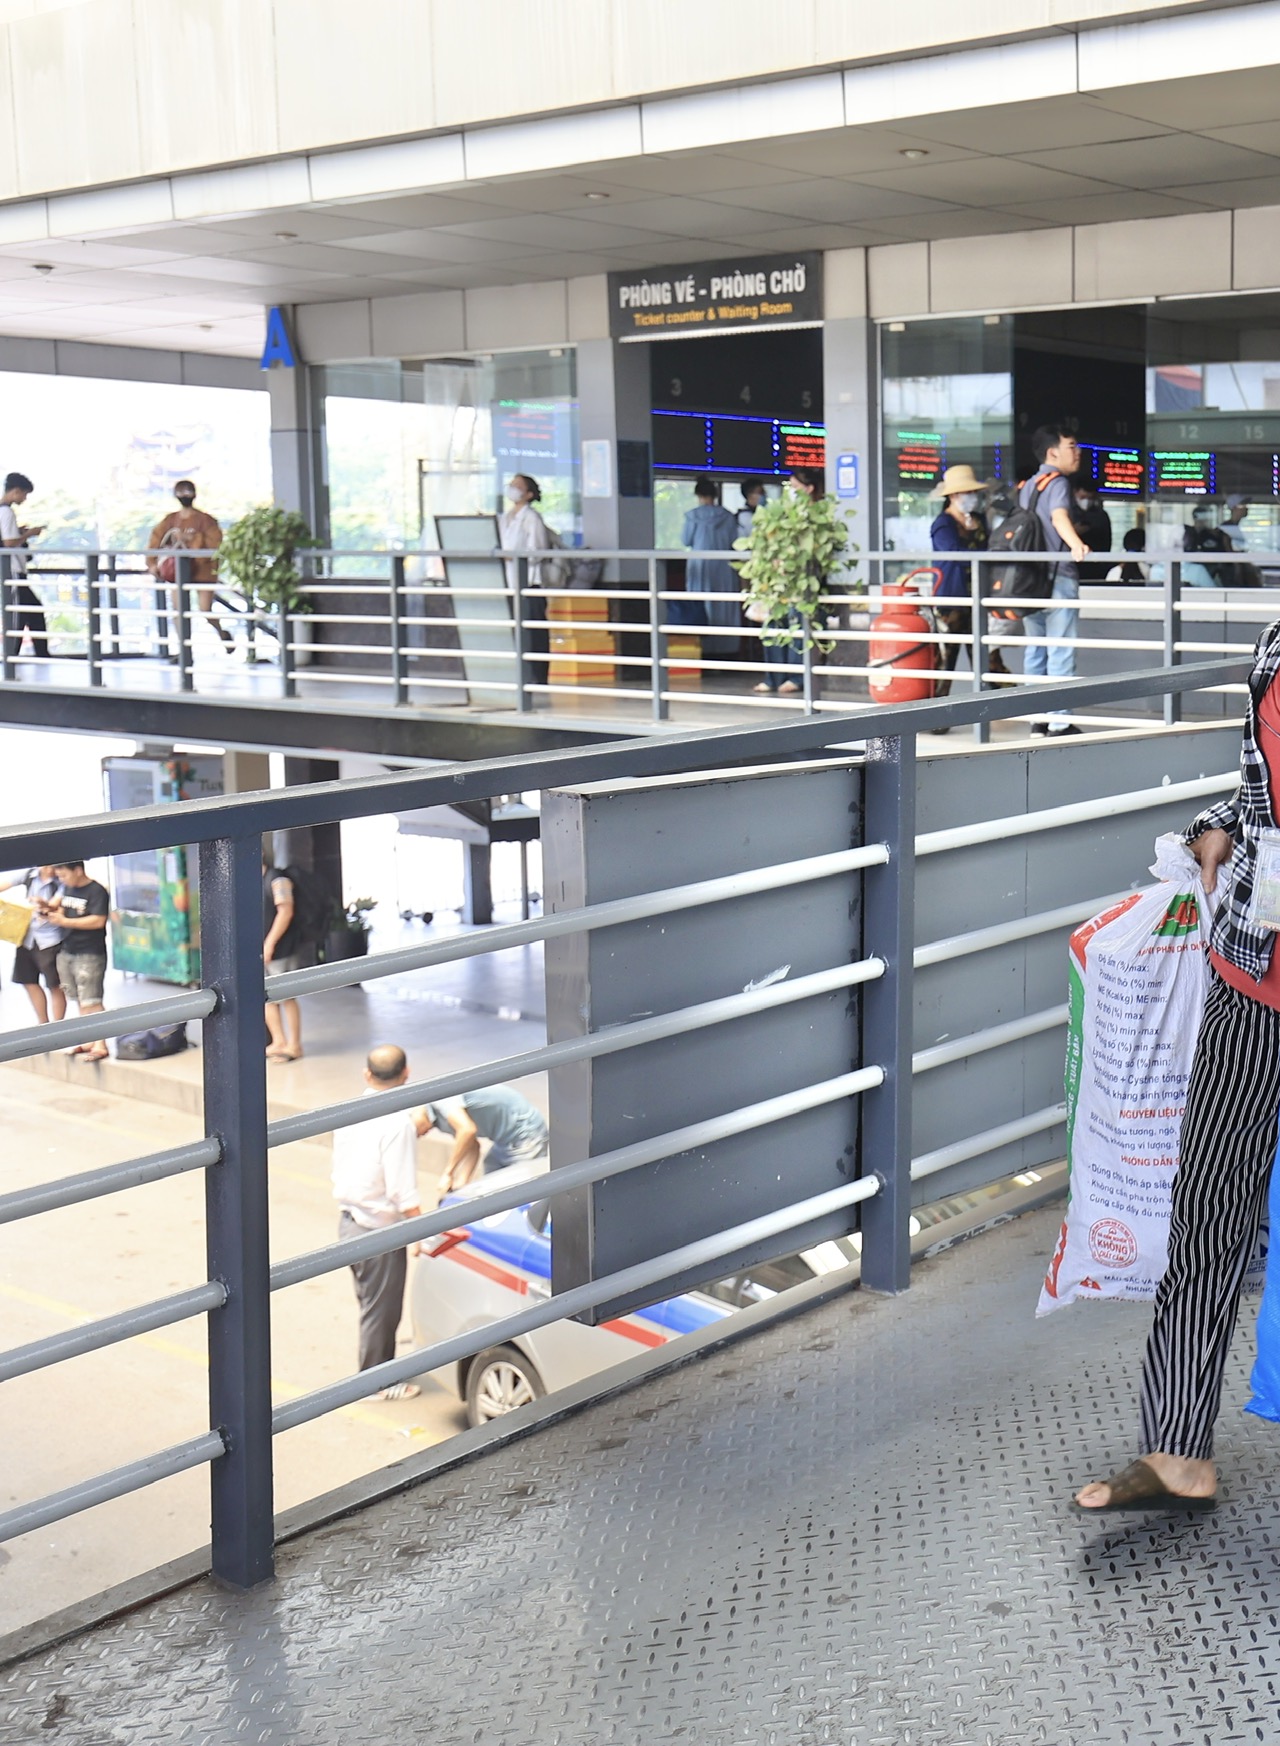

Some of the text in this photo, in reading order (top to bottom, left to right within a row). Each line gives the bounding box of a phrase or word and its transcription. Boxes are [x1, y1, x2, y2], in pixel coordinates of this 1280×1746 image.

[619, 278, 672, 308] PHÒNG
[674, 274, 696, 304] VÉ
[710, 270, 766, 300] PHÒNG
[770, 263, 806, 294] CHỜ
[633, 311, 665, 327] Ticket
[666, 309, 705, 324] counter
[718, 303, 758, 320] Waiting
[760, 302, 793, 316] Room
[261, 306, 296, 371] A
[671, 378, 682, 397] 3
[740, 386, 751, 404] 4
[802, 391, 811, 409] 5
[1179, 425, 1199, 440] 12
[1244, 425, 1264, 440] 15
[1130, 979, 1146, 990] (%)
[1136, 994, 1150, 1004] ME
[1120, 1026, 1136, 1036] min
[1117, 1042, 1132, 1054] (%)
[1141, 1090, 1160, 1100] sinh
[1097, 1239, 1128, 1255] KHÔNG
